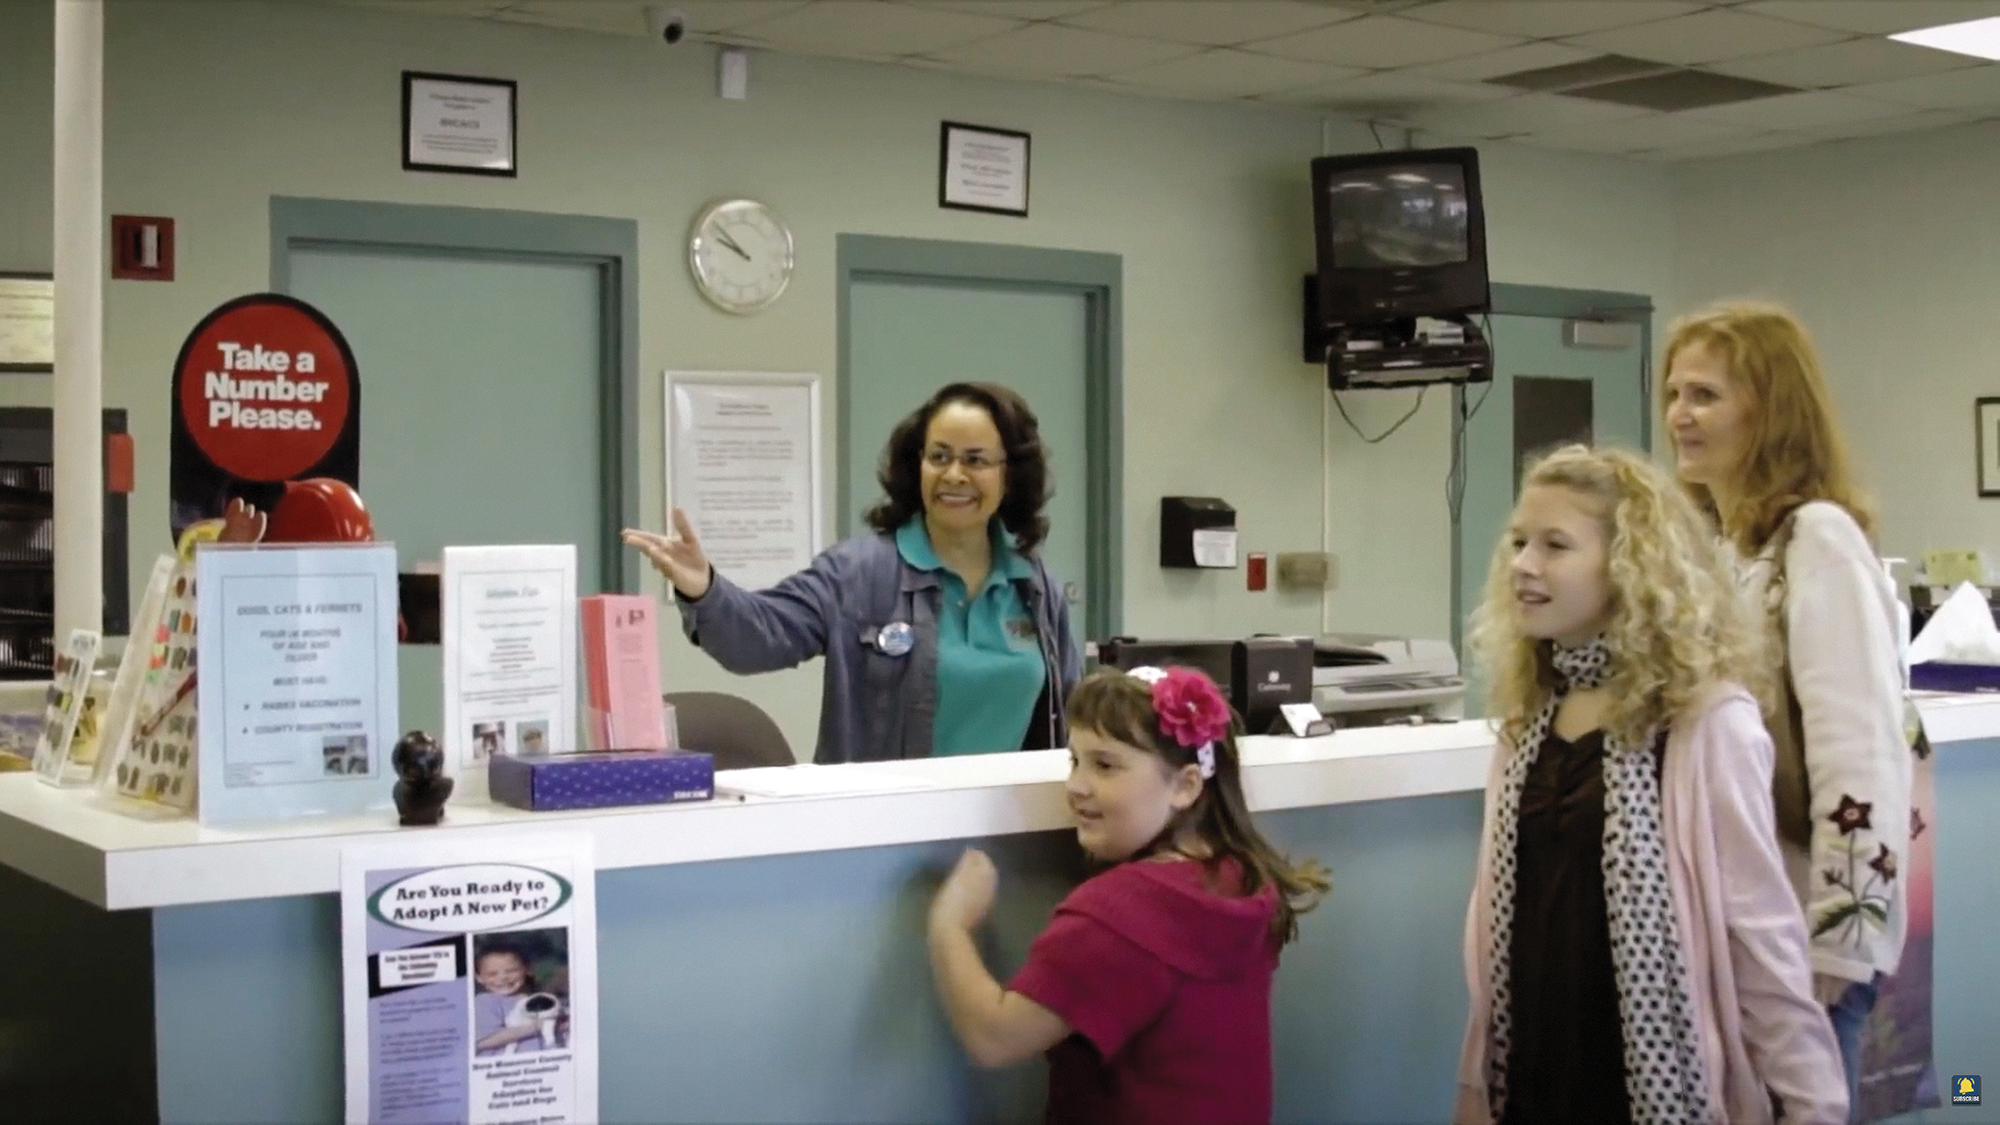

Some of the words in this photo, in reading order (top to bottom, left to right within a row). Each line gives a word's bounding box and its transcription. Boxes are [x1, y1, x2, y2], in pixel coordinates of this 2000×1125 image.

[217, 341, 291, 372] Take
[295, 351, 315, 373] a
[204, 371, 329, 402] Number
[208, 400, 322, 430] Please.
[274, 605, 301, 615] CATS
[396, 887, 427, 901] Are
[429, 885, 462, 897] You
[466, 880, 522, 895] Ready
[527, 880, 545, 891] to
[393, 907, 448, 921] Adopt
[452, 903, 464, 916] A
[468, 902, 505, 915] New
[511, 897, 549, 912] Pet?
